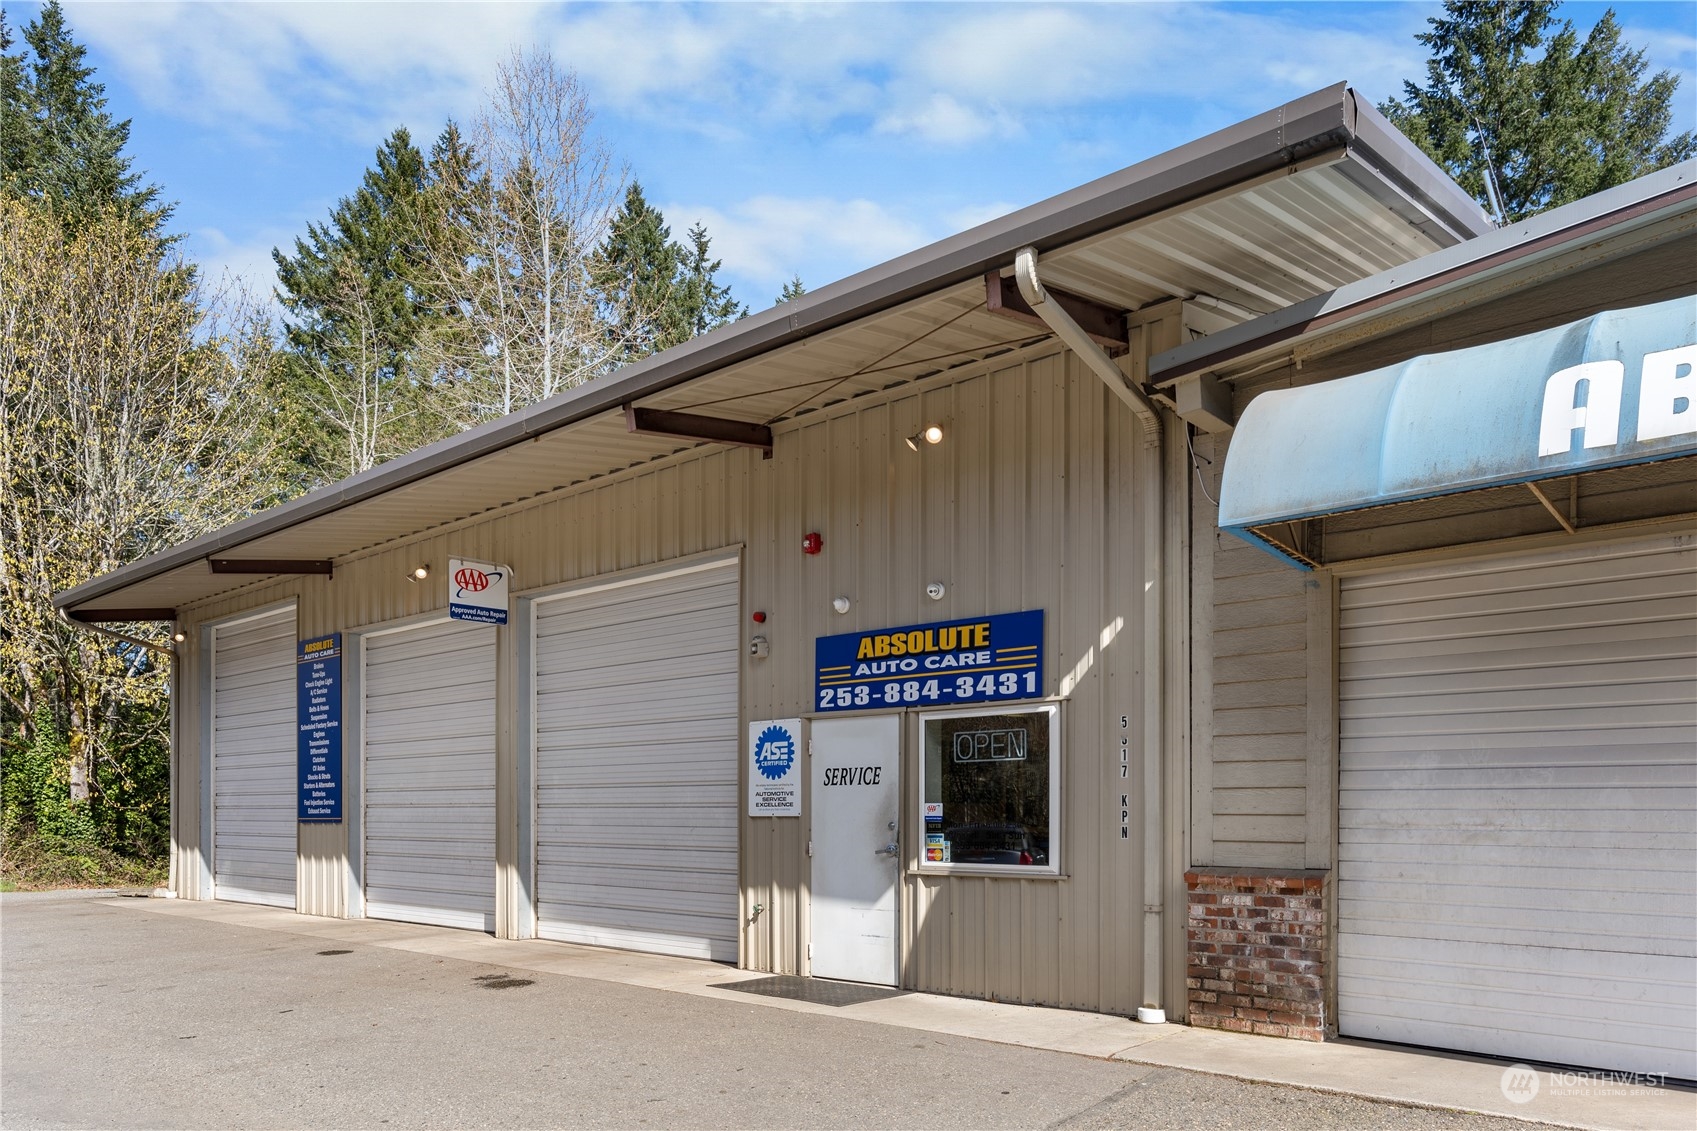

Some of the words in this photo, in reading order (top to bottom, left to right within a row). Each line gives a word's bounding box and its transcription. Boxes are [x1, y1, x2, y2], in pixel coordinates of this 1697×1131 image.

[1538, 344, 1697, 457] AB
[456, 568, 488, 592] AAA
[452, 606, 477, 615] Approved
[490, 611, 506, 619] Repair
[462, 614, 497, 622] AAA.com/Repair
[304, 639, 334, 653] ABSOLUTE
[856, 623, 990, 660] ABSOLUTE
[304, 652, 319, 660] AUTO
[320, 649, 334, 657] CARE
[855, 659, 918, 676] AUTO
[924, 651, 990, 668] CARE
[820, 671, 1036, 708] 253-884-3431
[760, 741, 788, 760] ASE
[957, 731, 1024, 759] OPEN
[824, 766, 882, 786] SERVICE
